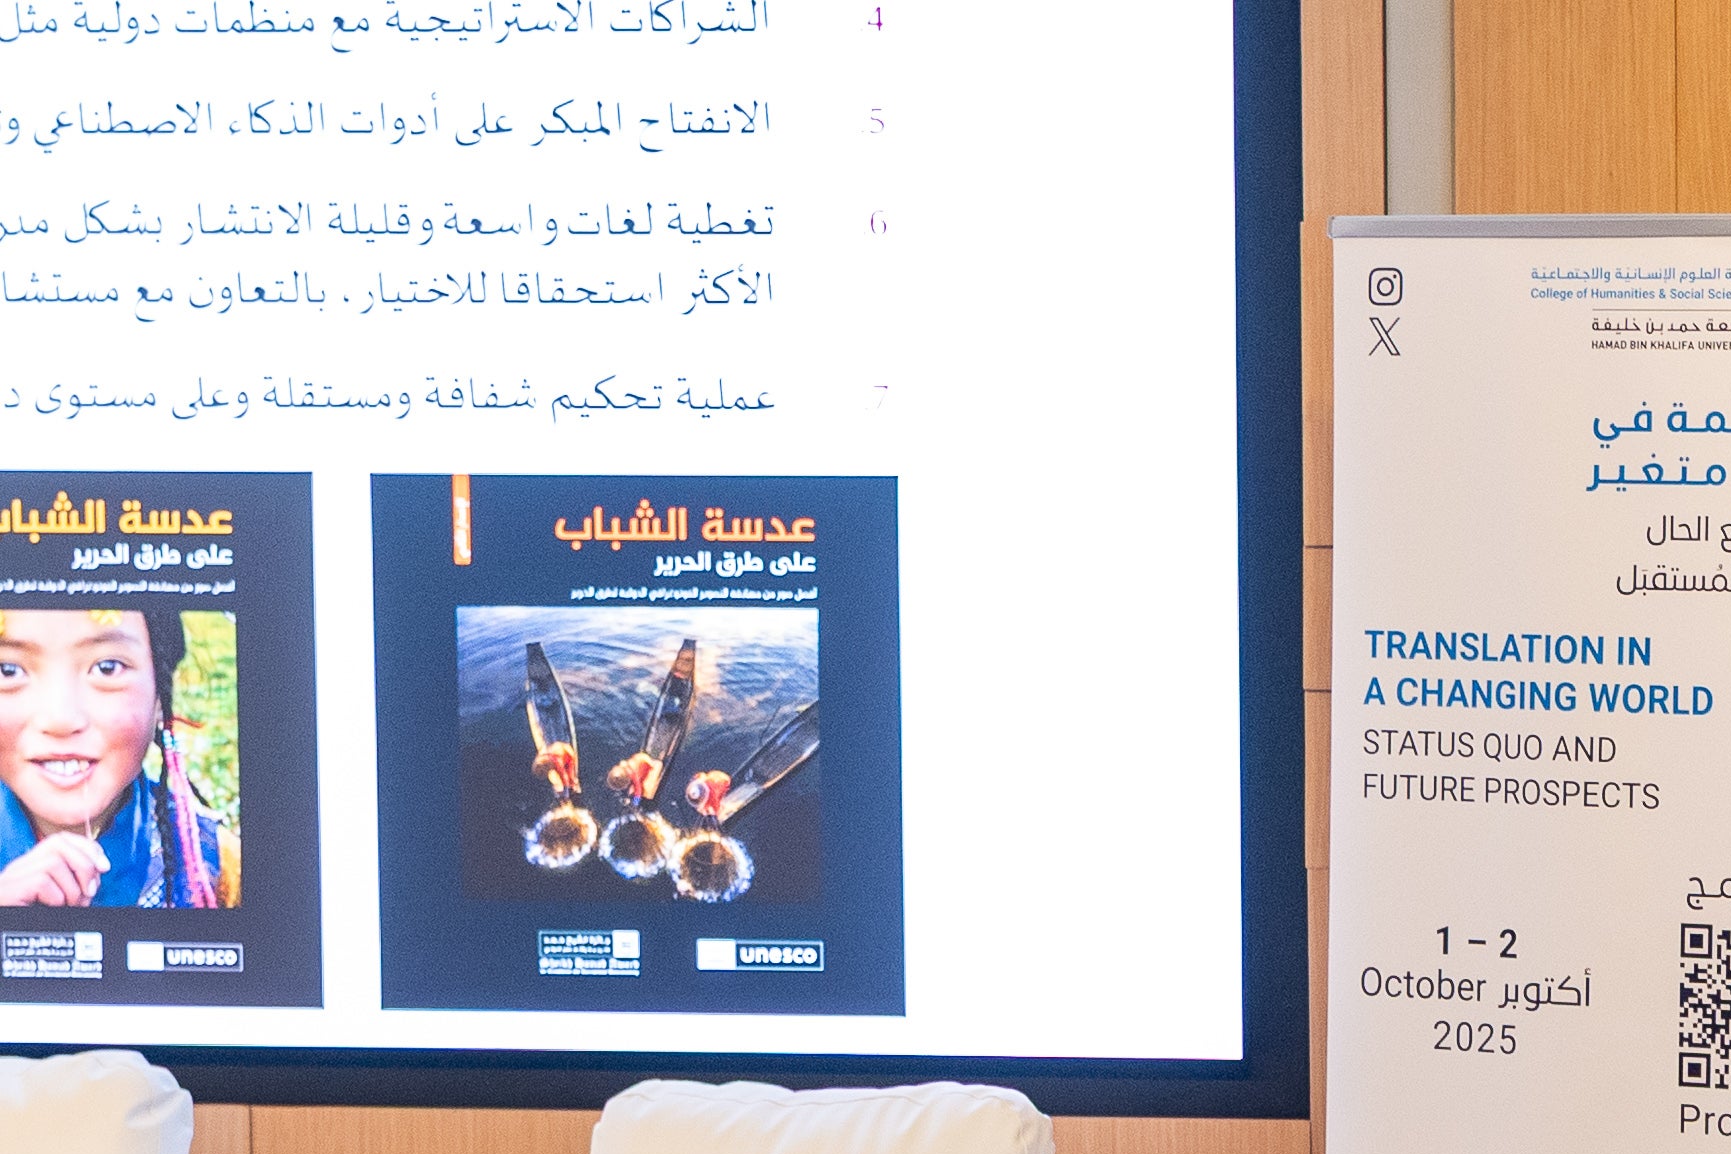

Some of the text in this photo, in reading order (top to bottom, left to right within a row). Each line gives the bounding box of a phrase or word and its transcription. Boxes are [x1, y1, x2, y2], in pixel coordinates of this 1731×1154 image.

[0, 3, 57, 43] مثل
[74, 0, 159, 44] دولية
[175, 0, 314, 33] منظمات
[332, 16, 369, 53] مع
[386, 0, 592, 44] الاستراتيجية
[610, 0, 768, 45] الشراكات
[34, 101, 211, 154] الاصطناعي
[229, 100, 324, 135] الذكاء
[341, 92, 438, 144] أدوات
[455, 102, 512, 146] على
[530, 99, 621, 146] المبكر
[640, 100, 769, 153] الانفتاح
[65, 200, 162, 243] بشكل
[180, 202, 311, 245] الانتشار
[328, 203, 433, 245] وقليلة
[444, 203, 558, 246] واسعة
[568, 202, 652, 235] لغات
[668, 202, 774, 244] تغطية
[189, 271, 325, 314] بالتعاون
[502, 272, 662, 303] استحقاقا
[682, 264, 772, 315] الأكثر
[1680, 268, 1720, 283] العلوم
[136, 286, 173, 323] مع
[1531, 288, 1573, 301] College
[1577, 288, 1587, 298] of
[1591, 289, 1655, 299] Humanities
[1659, 289, 1666, 299] &
[1670, 289, 1704, 299] Social
[1592, 318, 1641, 334] خليفة
[1646, 318, 1663, 334] بن
[1668, 323, 1701, 333] حمد
[1592, 340, 1627, 349] HAMAD
[1630, 340, 1647, 349] BIN
[1650, 341, 1694, 350] KHALIFA
[35, 384, 156, 419] مستوى
[172, 377, 248, 420] وعلى
[263, 376, 410, 419] ومستقلة
[426, 377, 536, 408] شفافة
[552, 375, 662, 423] تحكيم
[677, 378, 774, 418] عملية
[1593, 401, 1652, 449] في
[1586, 453, 1726, 492] متغير
[118, 499, 234, 535] عدسة
[554, 498, 816, 551] عدسة الشباب
[1647, 515, 1709, 546] الحال
[71, 542, 234, 571] على طرق الحرير
[653, 551, 817, 578] على طرق الحرير
[1364, 630, 1651, 666] TRANSLATION IN
[1363, 677, 1713, 715] A CHANGING WORLD
[1364, 729, 1616, 762] STATUS QUO AND
[1364, 773, 1659, 809] FUTURE PROSPECTS
[166, 949, 239, 967] unesco
[739, 945, 819, 965] unesco
[1437, 926, 1449, 955] 1
[1500, 929, 1517, 959] 2
[1361, 967, 1591, 1011] October أكتوبر
[1434, 1021, 1516, 1054] 2025
